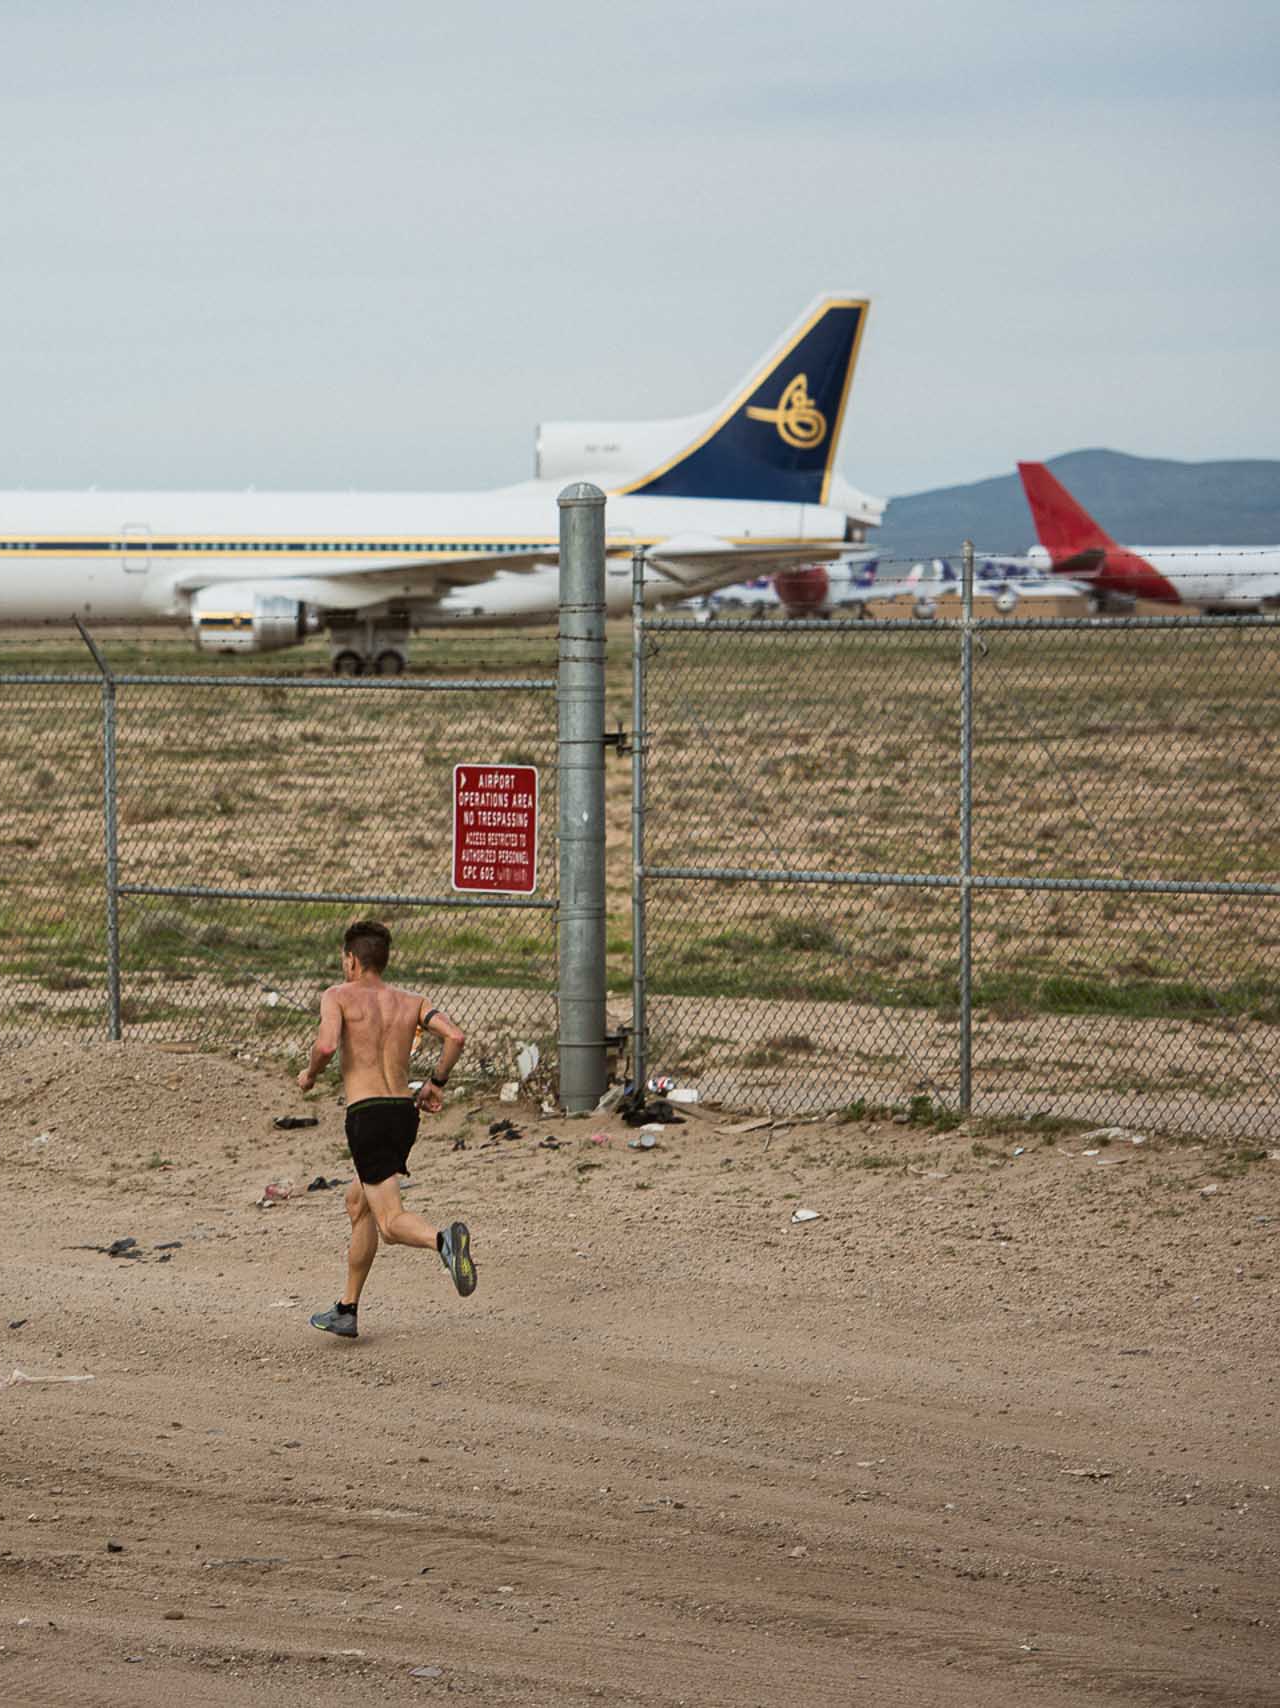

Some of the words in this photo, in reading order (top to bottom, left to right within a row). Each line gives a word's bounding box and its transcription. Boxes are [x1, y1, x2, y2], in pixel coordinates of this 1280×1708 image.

[478, 773, 515, 789] AIRPORT
[459, 791, 509, 808] OPERATIONS
[512, 793, 533, 808] AREA
[463, 811, 474, 826] NO
[478, 811, 528, 828] TRESPASSING
[480, 866, 494, 880] 602
